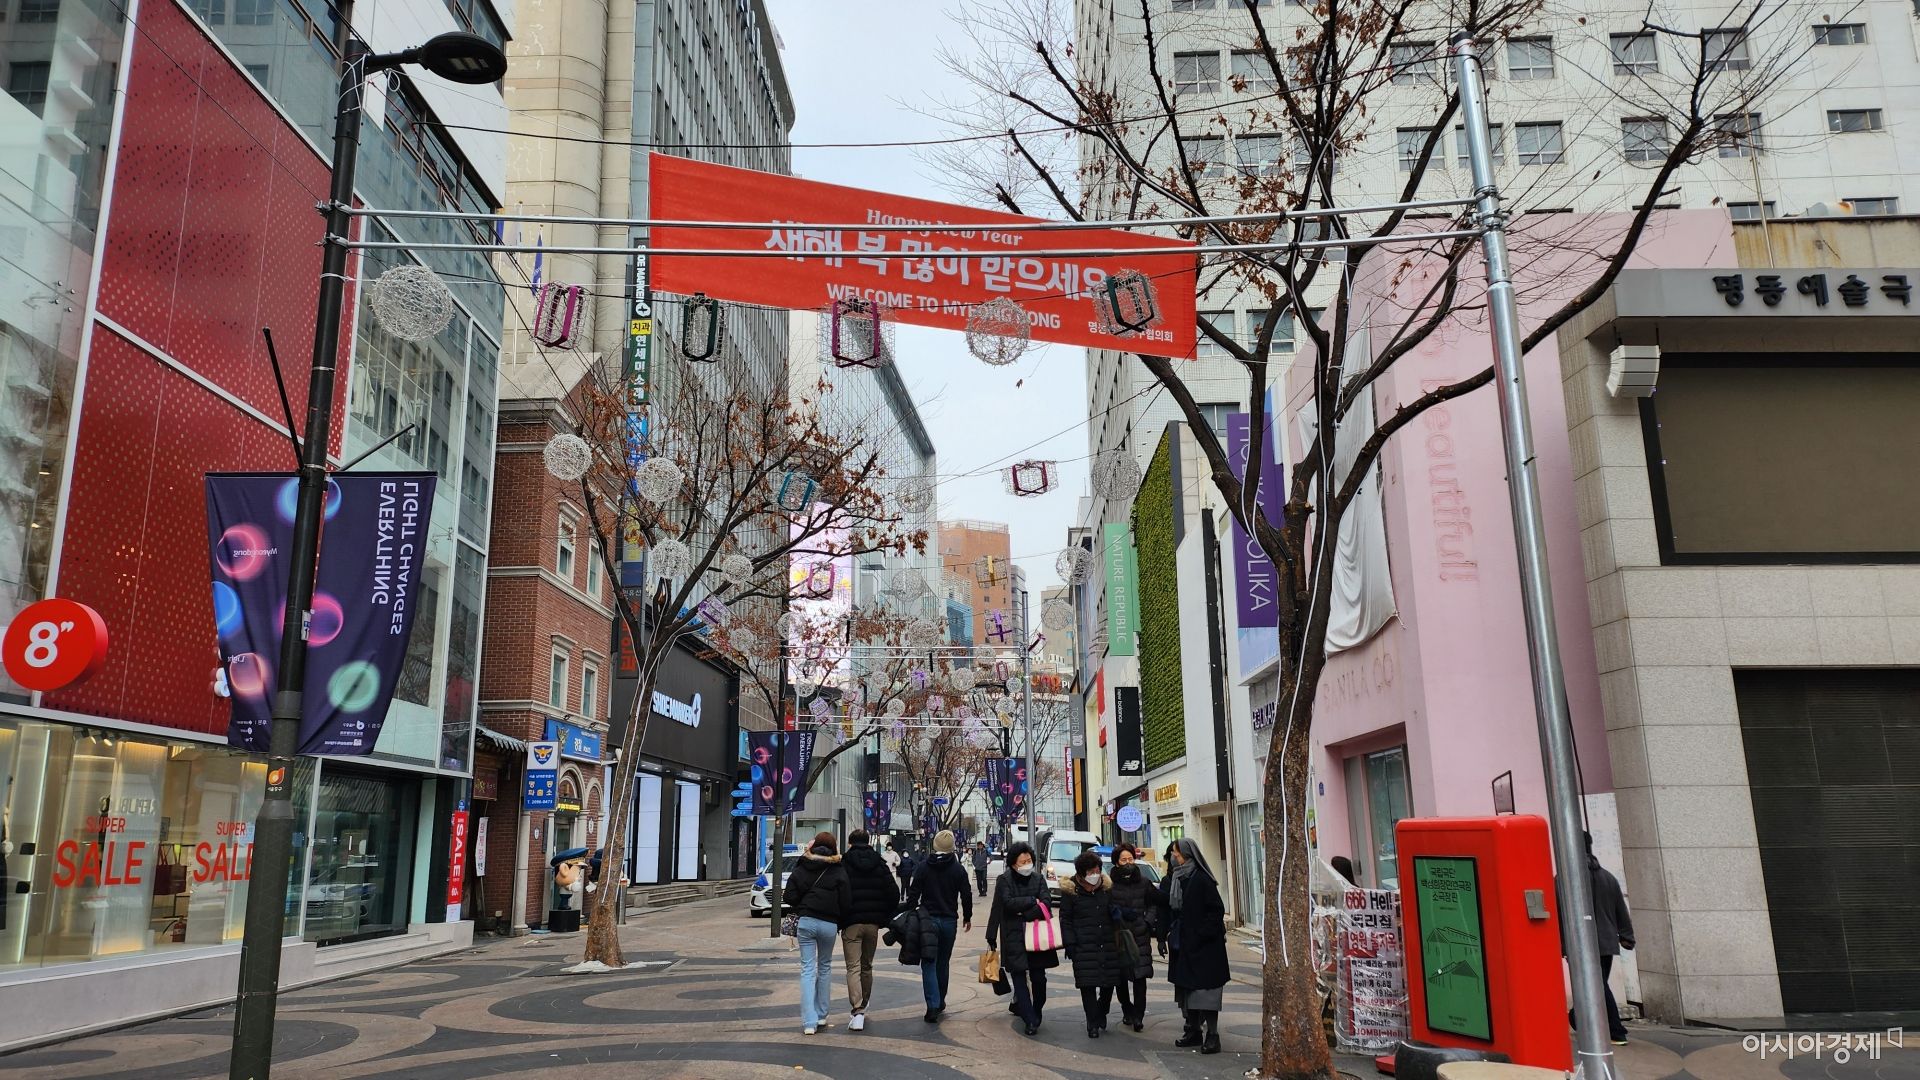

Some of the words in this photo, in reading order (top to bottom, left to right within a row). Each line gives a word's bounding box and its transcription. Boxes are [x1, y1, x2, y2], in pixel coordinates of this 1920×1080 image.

[637, 244, 647, 267] SOE
[981, 229, 1023, 246] Year
[765, 220, 842, 268] 새해
[854, 230, 890, 275] 복
[900, 238, 969, 286] 많이
[980, 254, 1110, 301] 받으세요
[827, 282, 912, 307] WELCOME
[916, 295, 938, 312] TO
[943, 299, 1060, 329] MYEONGONG
[1712, 273, 1912, 307] 명동예술극
[632, 321, 650, 332] 치과
[1112, 534, 1126, 584] NATURE
[1246, 534, 1271, 611] OLIKA
[1113, 586, 1127, 644] REPUBLIC
[86, 816, 126, 833] SUPER
[216, 821, 246, 836] SUPER
[53, 840, 146, 889] SALE
[453, 823, 464, 877] SALE
[1345, 891, 1366, 909] 666
